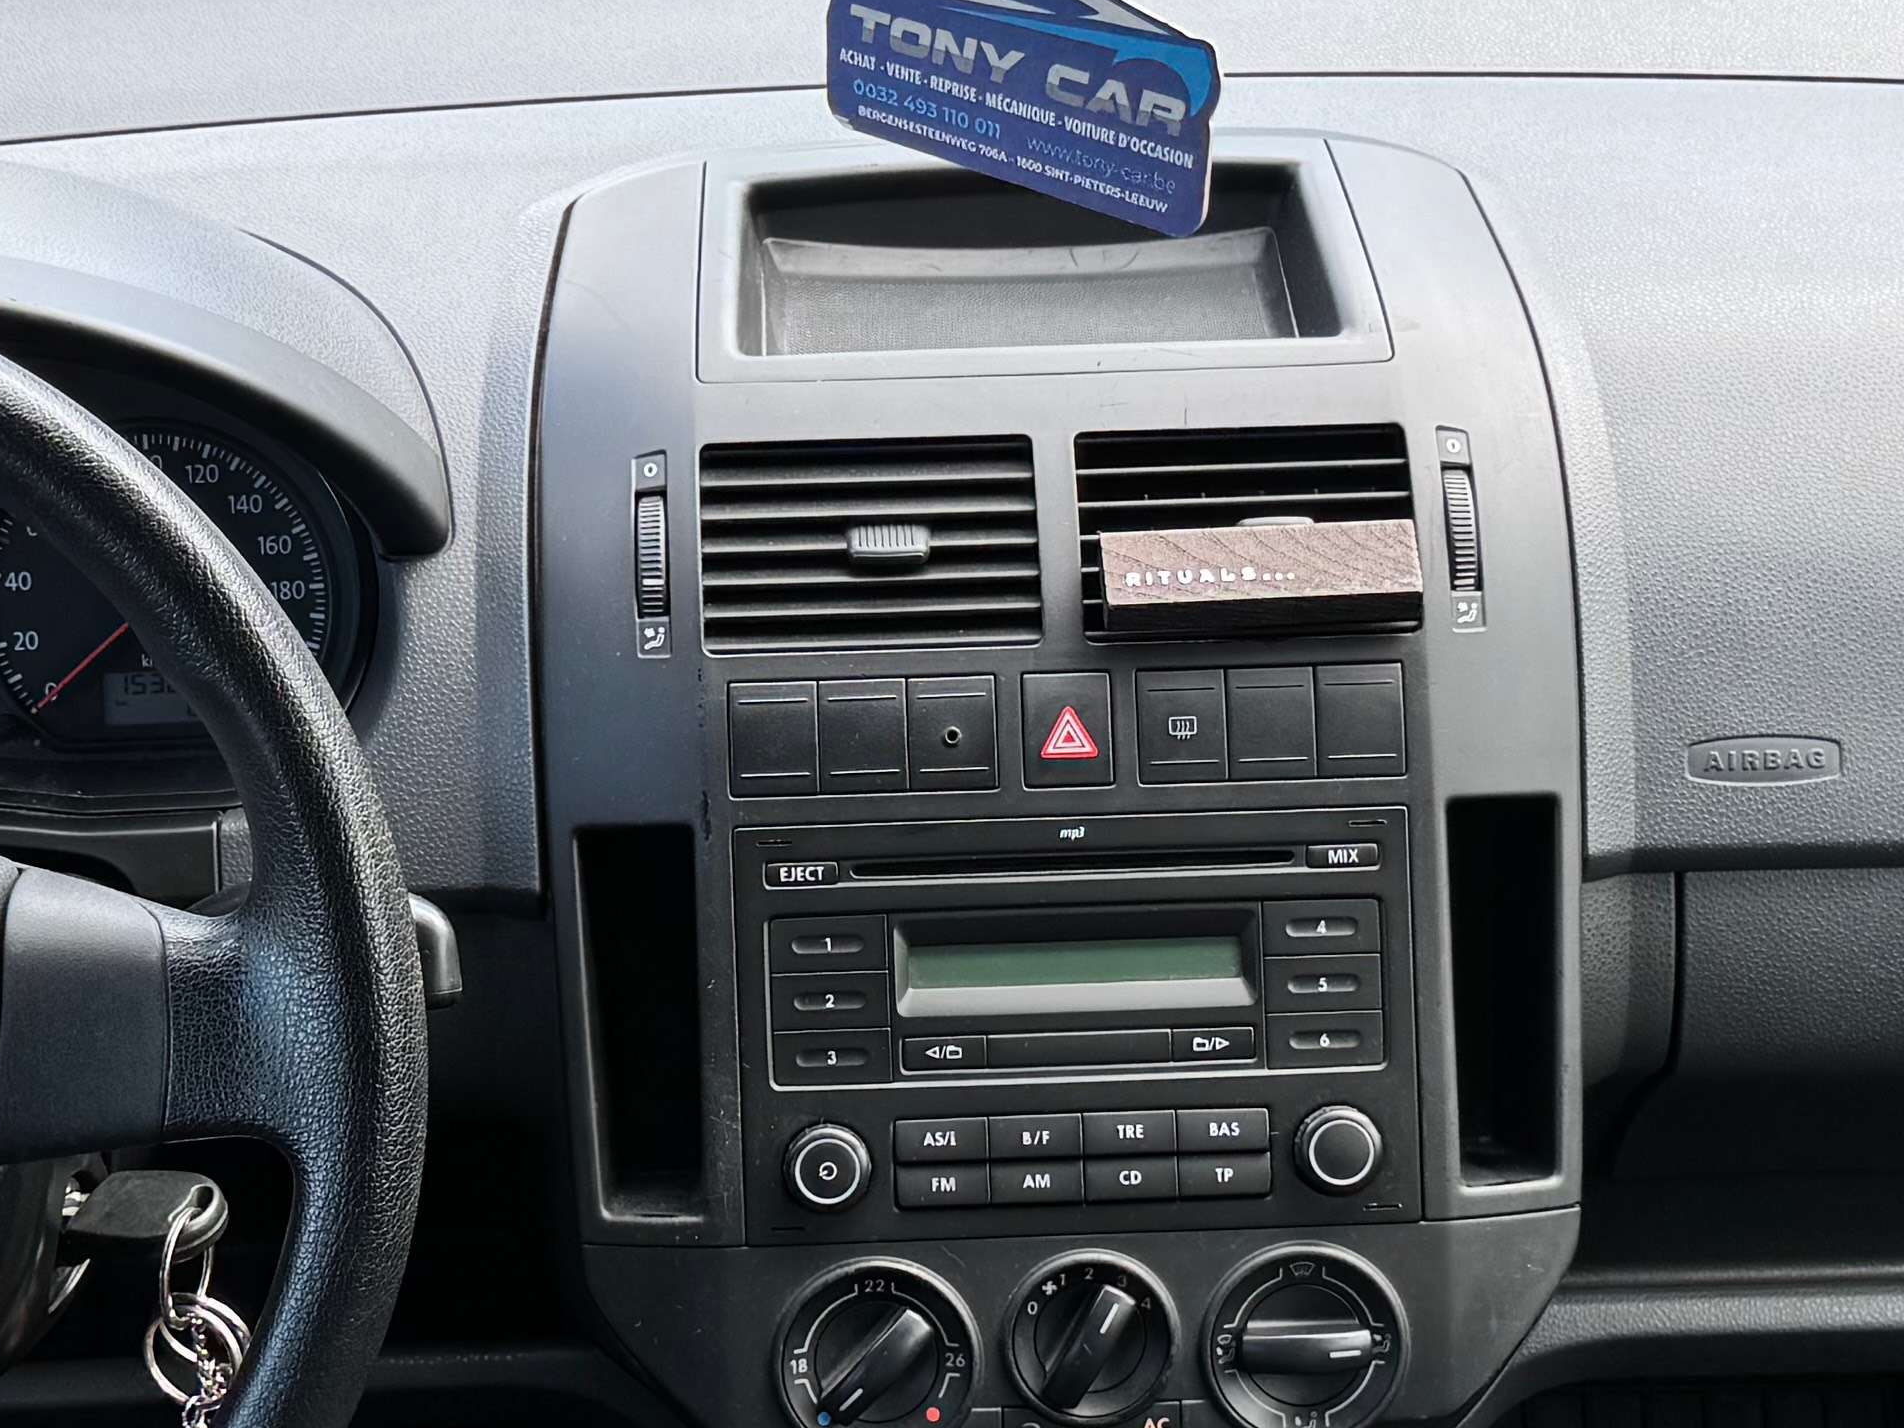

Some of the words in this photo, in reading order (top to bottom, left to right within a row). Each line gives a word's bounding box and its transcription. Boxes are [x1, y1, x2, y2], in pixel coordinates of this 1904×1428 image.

[850, 4, 1025, 84] TONY
[1046, 63, 1186, 137] CAR
[839, 47, 877, 71] ACHAT
[886, 61, 922, 85] VENTE
[930, 75, 977, 103] REPRISE
[985, 90, 1056, 127] MÉCANIQUE
[1064, 115, 1116, 145] VOITURE
[1118, 134, 1194, 169] D'OCCASION
[853, 79, 898, 107] 0032
[903, 94, 938, 118] 493
[942, 107, 969, 129] 110
[974, 118, 1000, 141] 011
[185, 464, 219, 484] 120
[228, 494, 263, 515] 140
[257, 535, 292, 556] 160
[5, 572, 32, 592] 40
[271, 580, 305, 601] 180
[13, 630, 40, 651] 20
[1703, 747, 1826, 772] AIRBAG
[1059, 826, 1086, 841] mp3
[1327, 847, 1360, 865] MIX
[779, 865, 825, 882] EJECT
[1316, 919, 1327, 934] 4
[824, 937, 832, 952] 1
[1318, 976, 1328, 992] 5
[825, 994, 835, 1009] 2
[1319, 1033, 1330, 1048] 6
[827, 1050, 837, 1065] 3
[1022, 1130, 1050, 1145] B/F
[1116, 1124, 1144, 1140] TRE
[1209, 1122, 1241, 1137] BAS
[1022, 1173, 1051, 1189] AM
[1119, 1170, 1142, 1186] CD
[1215, 1167, 1234, 1183] TP
[931, 1176, 956, 1192] FM
[1060, 1274, 1066, 1286] 1
[1084, 1267, 1094, 1280] 2
[864, 1279, 886, 1293] 22
[1027, 1301, 1038, 1315] 0
[790, 1359, 808, 1374] 18
[945, 1352, 965, 1368] 26
